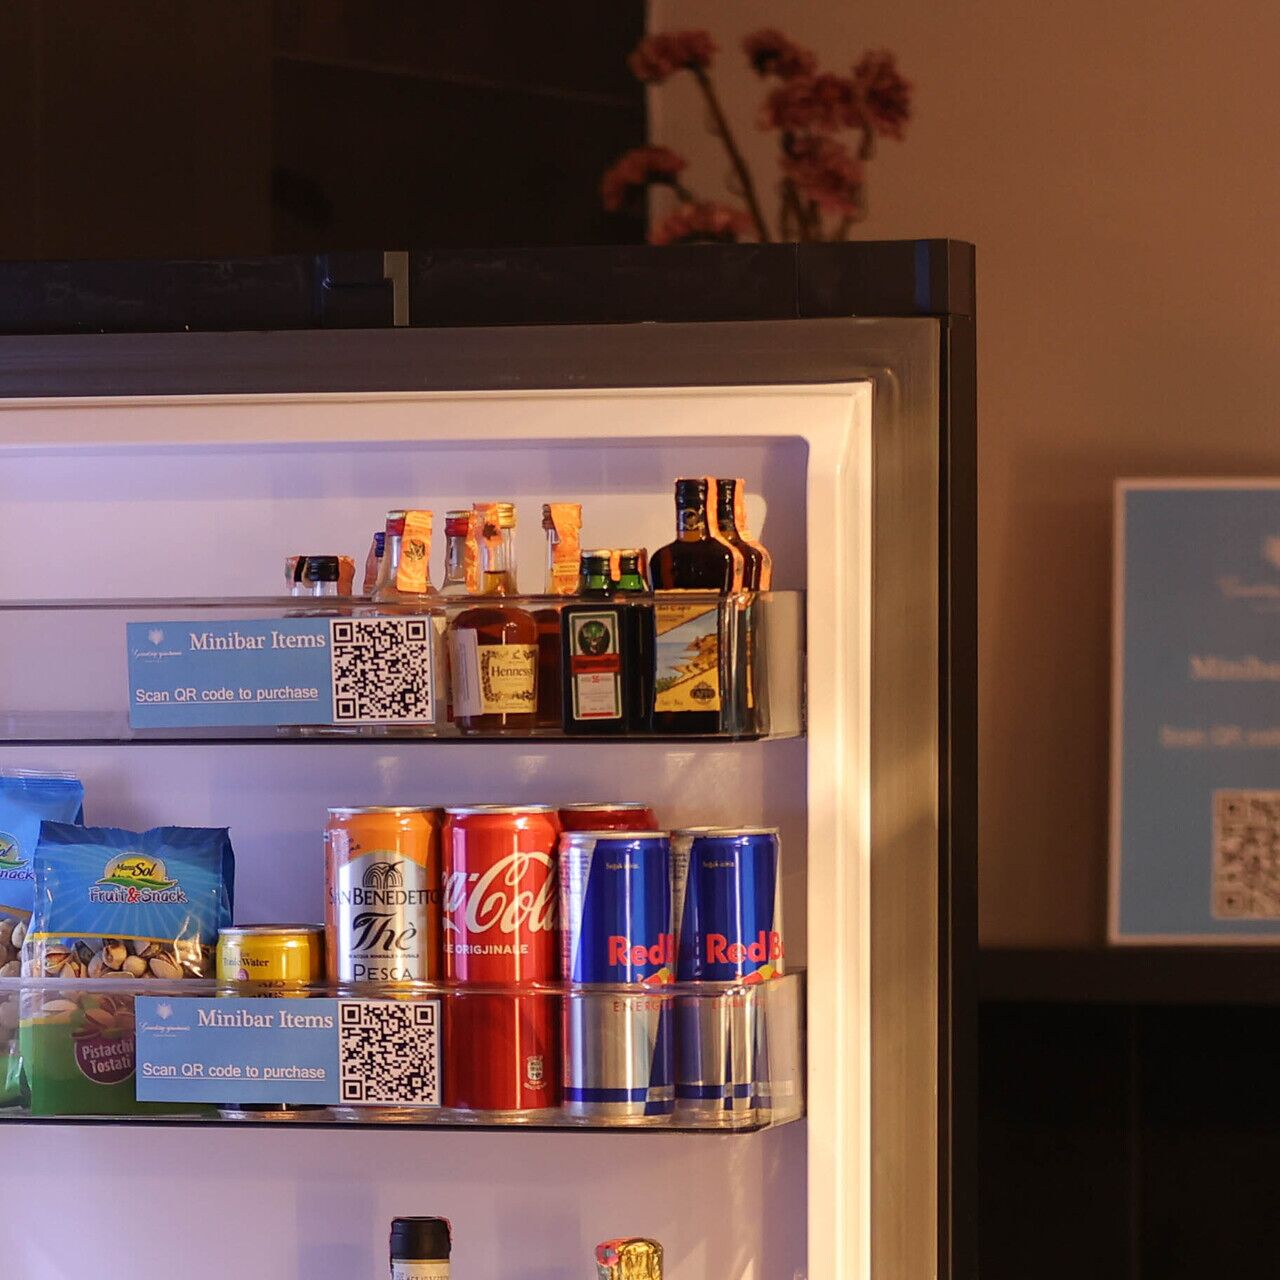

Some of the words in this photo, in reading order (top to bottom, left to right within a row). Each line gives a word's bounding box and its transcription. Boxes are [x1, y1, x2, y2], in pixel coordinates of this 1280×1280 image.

[189, 631, 266, 651] Minibar
[270, 630, 326, 649] Items
[135, 688, 170, 703] Scan
[174, 687, 197, 702] QR
[201, 686, 234, 701] code
[239, 687, 252, 700] to
[256, 685, 319, 702] purchase
[89, 887, 128, 902] Fruit
[141, 887, 188, 903] Snack
[352, 911, 418, 951] Thè
[455, 944, 529, 955] ORIGJINALE
[607, 933, 665, 966] Red
[705, 931, 768, 964] Red
[241, 957, 270, 967] Water
[354, 963, 414, 983] PESCA
[197, 1008, 274, 1028] Minibar
[278, 1009, 335, 1029] Items
[90, 1055, 132, 1075] Tostati
[142, 1062, 177, 1077] Scan
[181, 1063, 204, 1078] QR
[208, 1063, 241, 1078] code
[246, 1065, 259, 1078] to
[263, 1064, 326, 1081] purchase
